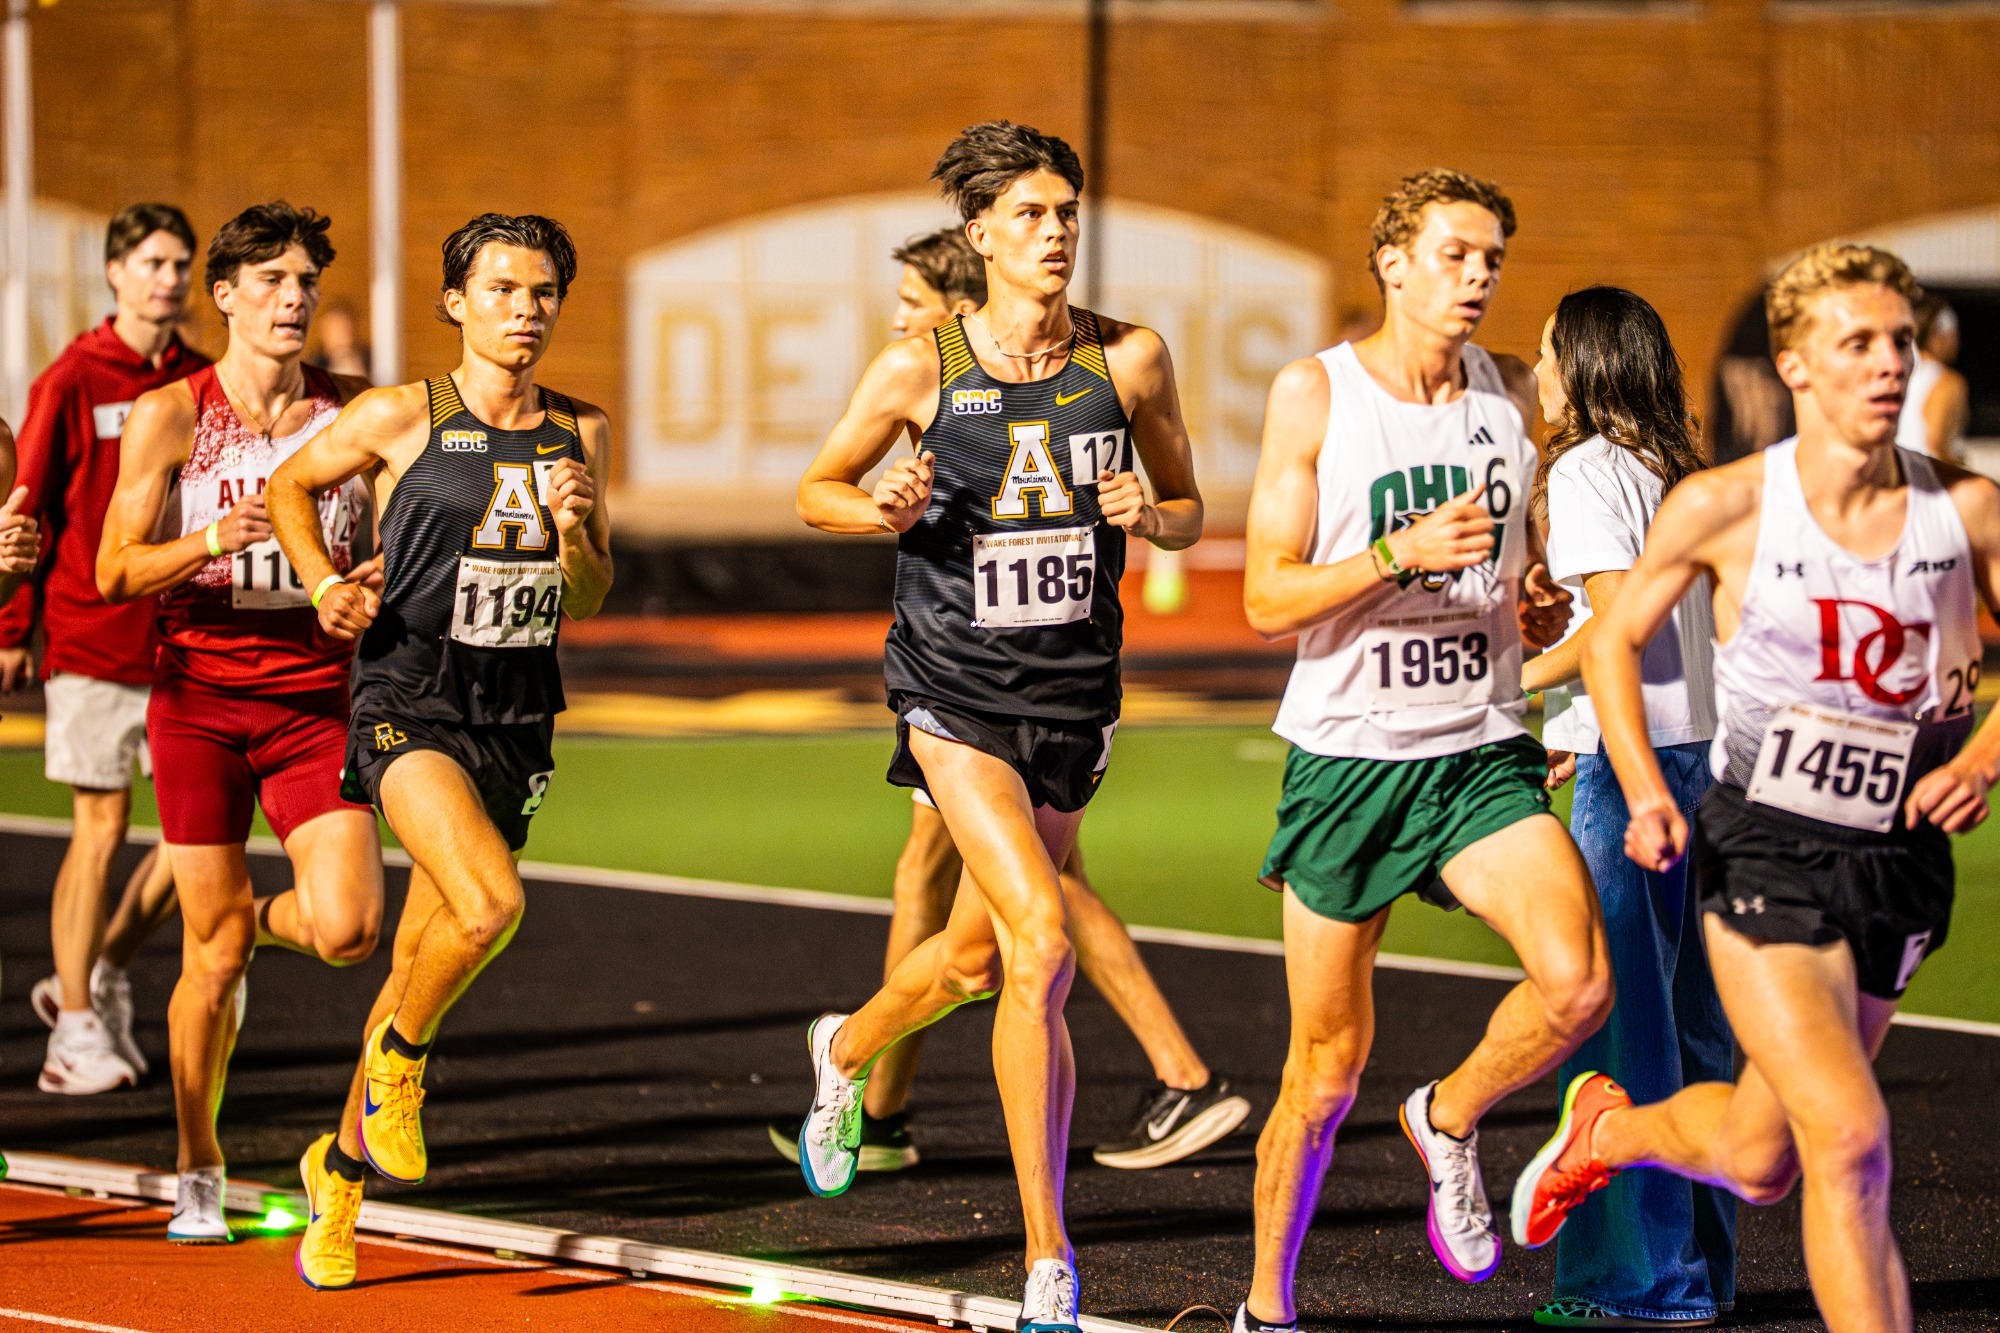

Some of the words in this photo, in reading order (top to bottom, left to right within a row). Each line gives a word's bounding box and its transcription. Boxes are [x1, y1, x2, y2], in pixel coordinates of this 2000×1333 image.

[952, 389, 1002, 415] SBC
[441, 430, 488, 453] SBC
[991, 420, 1074, 519] A
[1083, 435, 1117, 481] 12
[472, 462, 550, 550] A
[1367, 465, 1506, 563] OHI
[1486, 457, 1511, 519] 6
[985, 539, 1006, 548] WAKE
[1008, 537, 1034, 546] FOREST
[1036, 533, 1083, 545] INVITATIONAL
[471, 564, 492, 574] WAKE
[493, 566, 517, 576] FOREST
[978, 553, 1093, 608] 1185
[460, 583, 558, 628] 1194
[1371, 631, 1488, 689] 1953
[1808, 598, 1932, 707] DC
[1769, 728, 1905, 805] 1455
